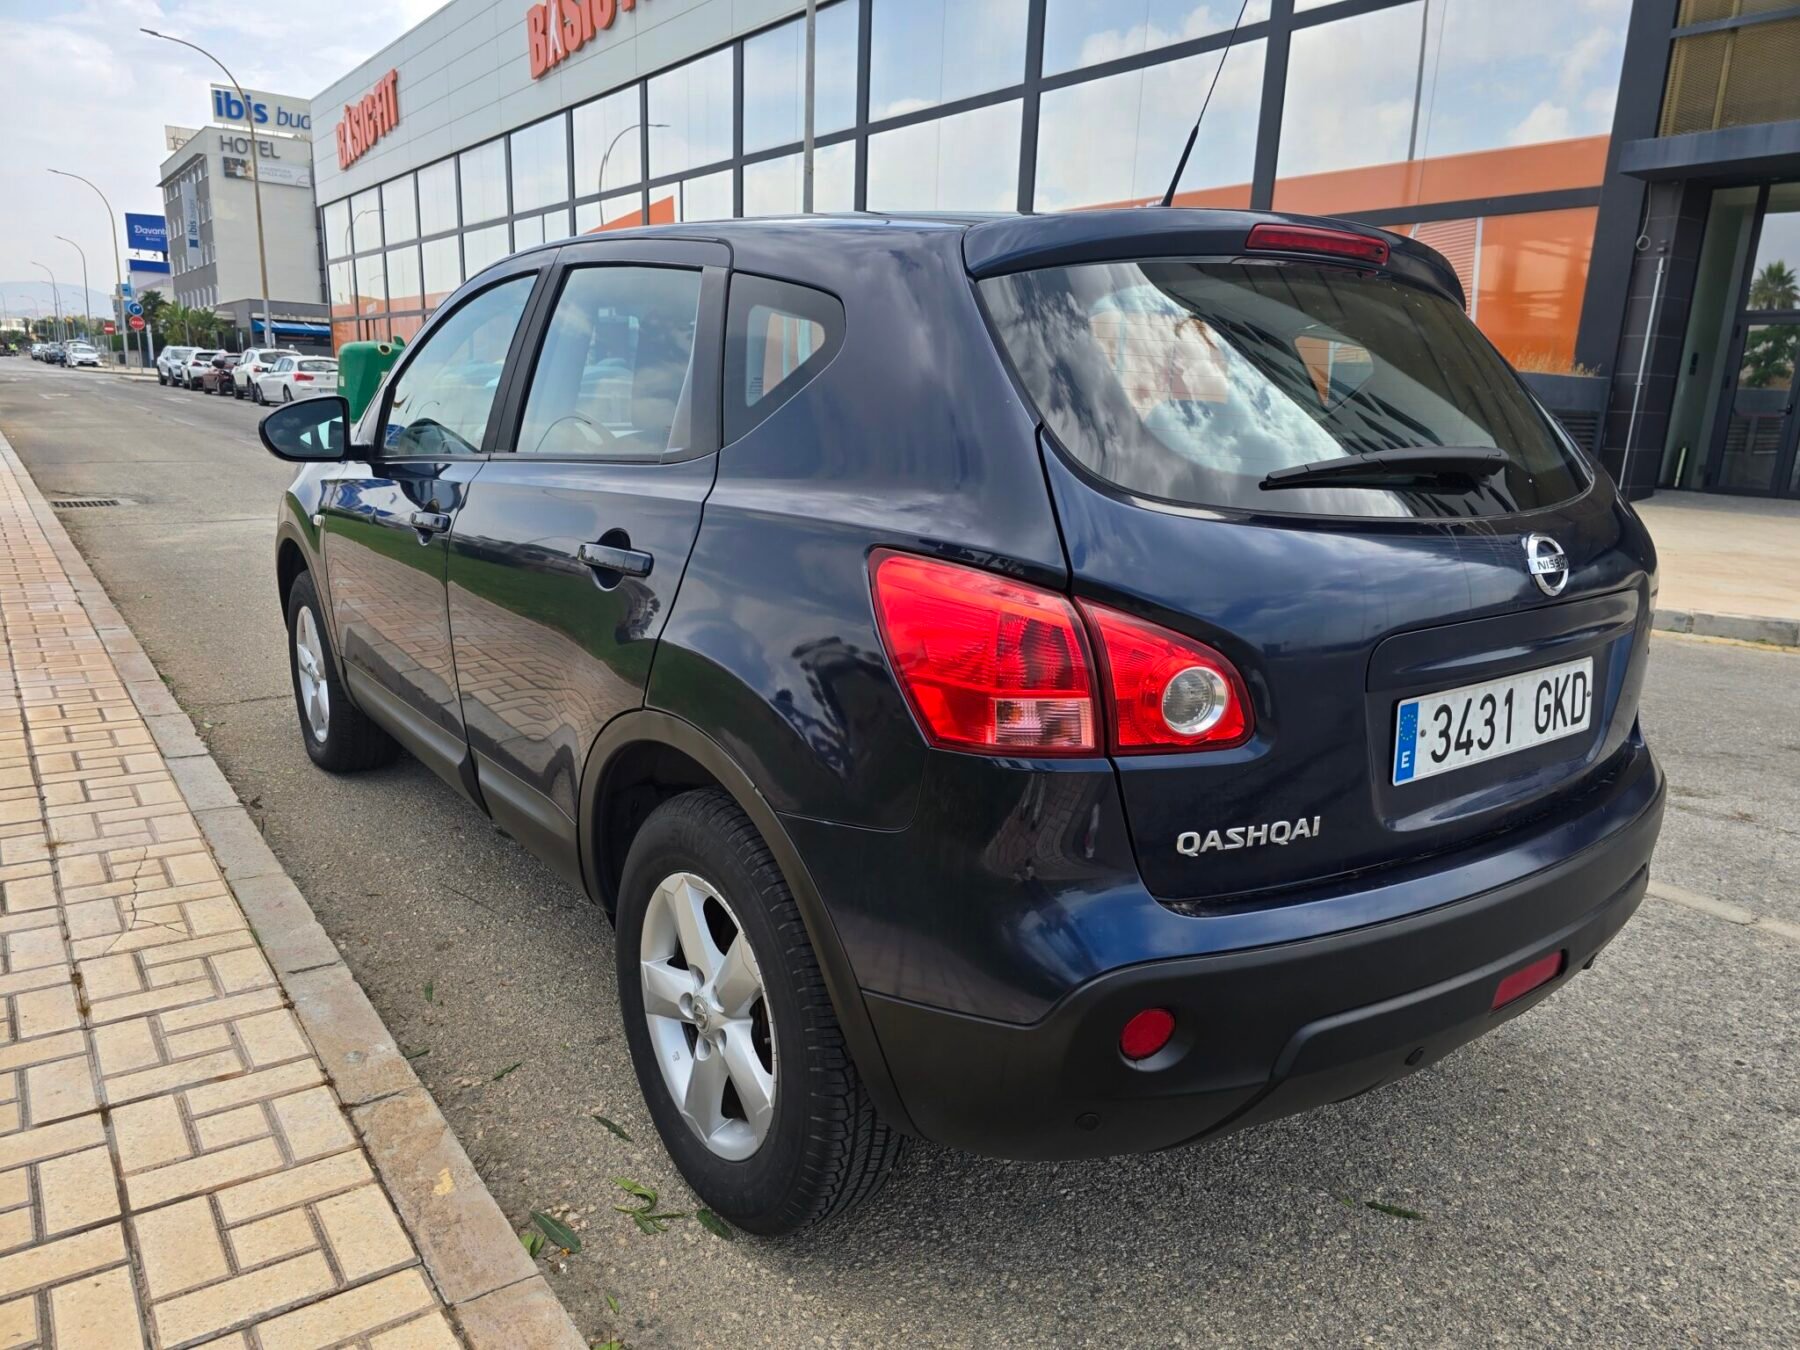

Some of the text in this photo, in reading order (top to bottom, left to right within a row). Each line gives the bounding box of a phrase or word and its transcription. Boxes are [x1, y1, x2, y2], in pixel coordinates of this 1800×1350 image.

[215, 90, 268, 124] ibis
[1401, 671, 1587, 768] E 3431 GKD
[1176, 815, 1321, 857] QASHQAI
